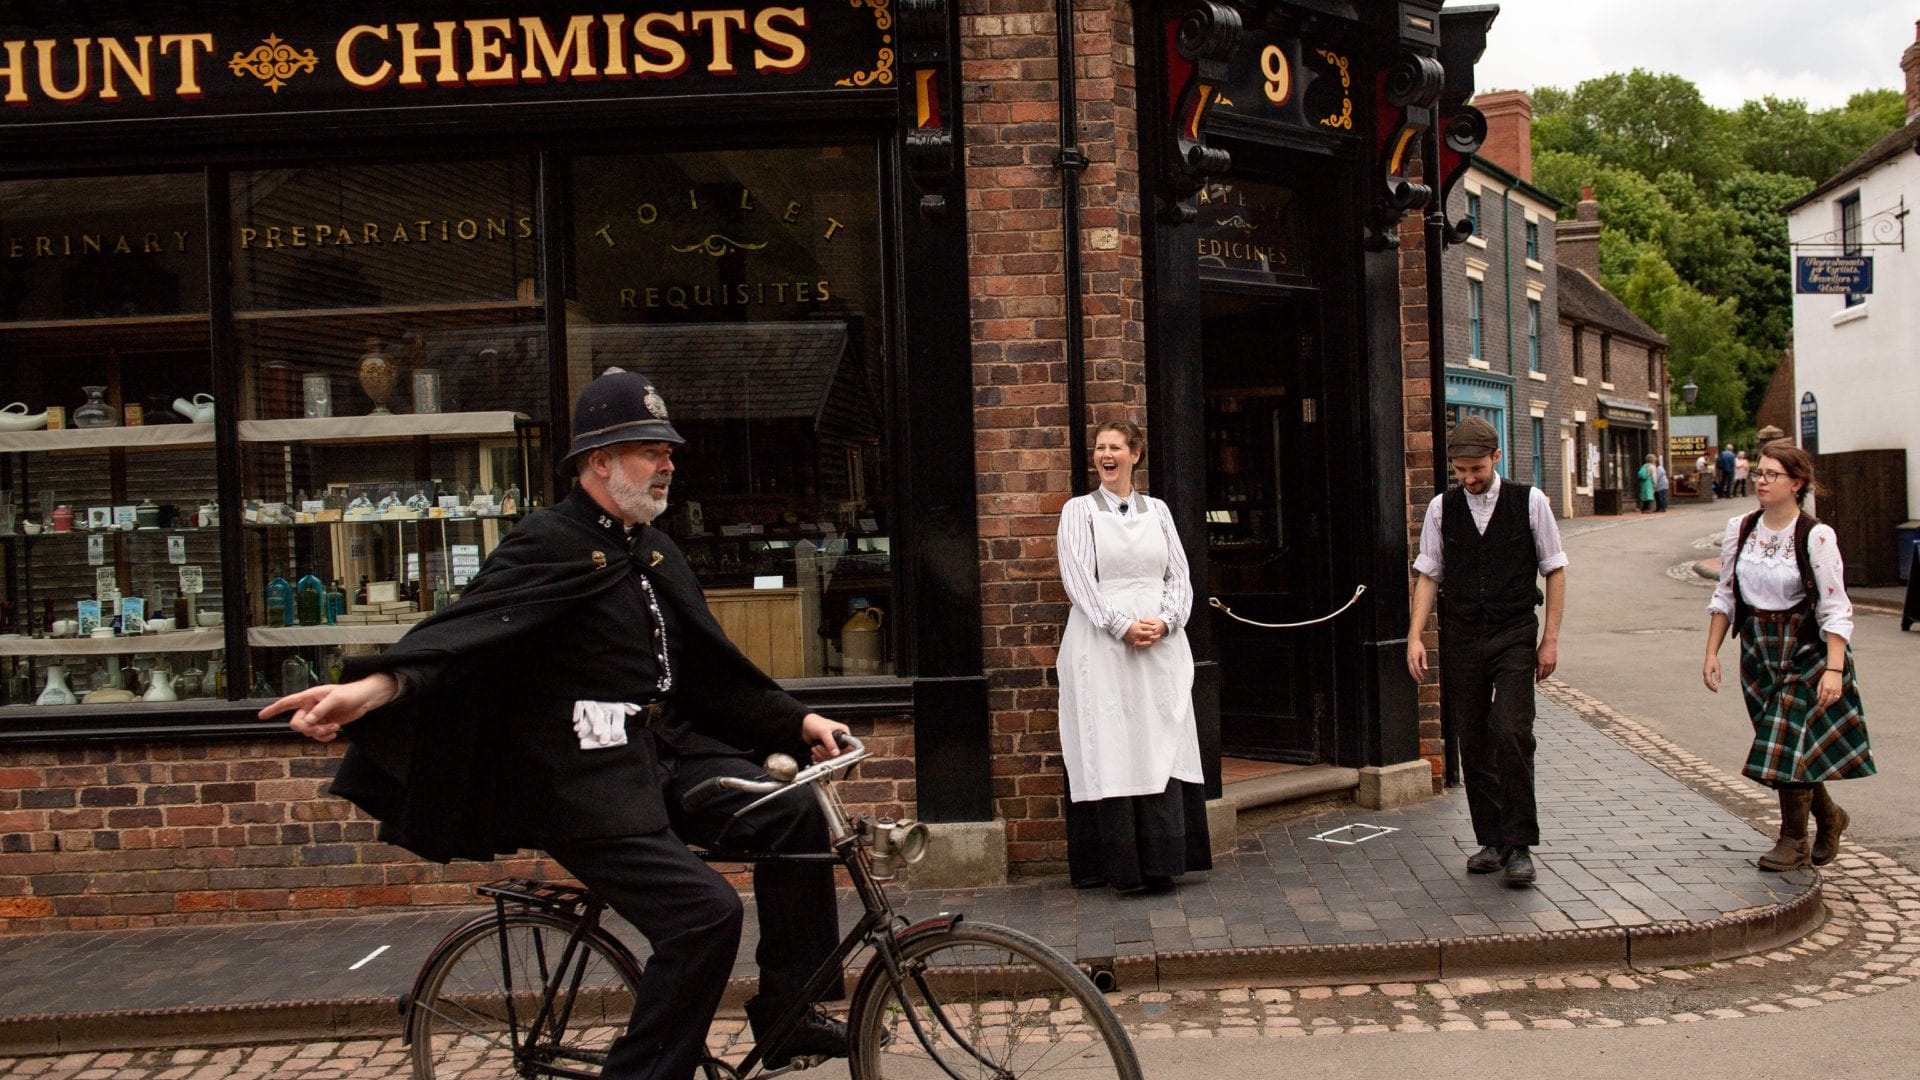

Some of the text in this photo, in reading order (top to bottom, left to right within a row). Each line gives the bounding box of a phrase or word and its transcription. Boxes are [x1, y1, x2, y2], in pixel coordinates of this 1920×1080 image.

[336, 7, 808, 88] CHEMISTS
[1261, 45, 1290, 103] 9
[240, 217, 533, 248] PREPARATIONS
[594, 189, 845, 249] TOILET
[620, 280, 831, 310] REQUISITES
[598, 514, 613, 529] 25
